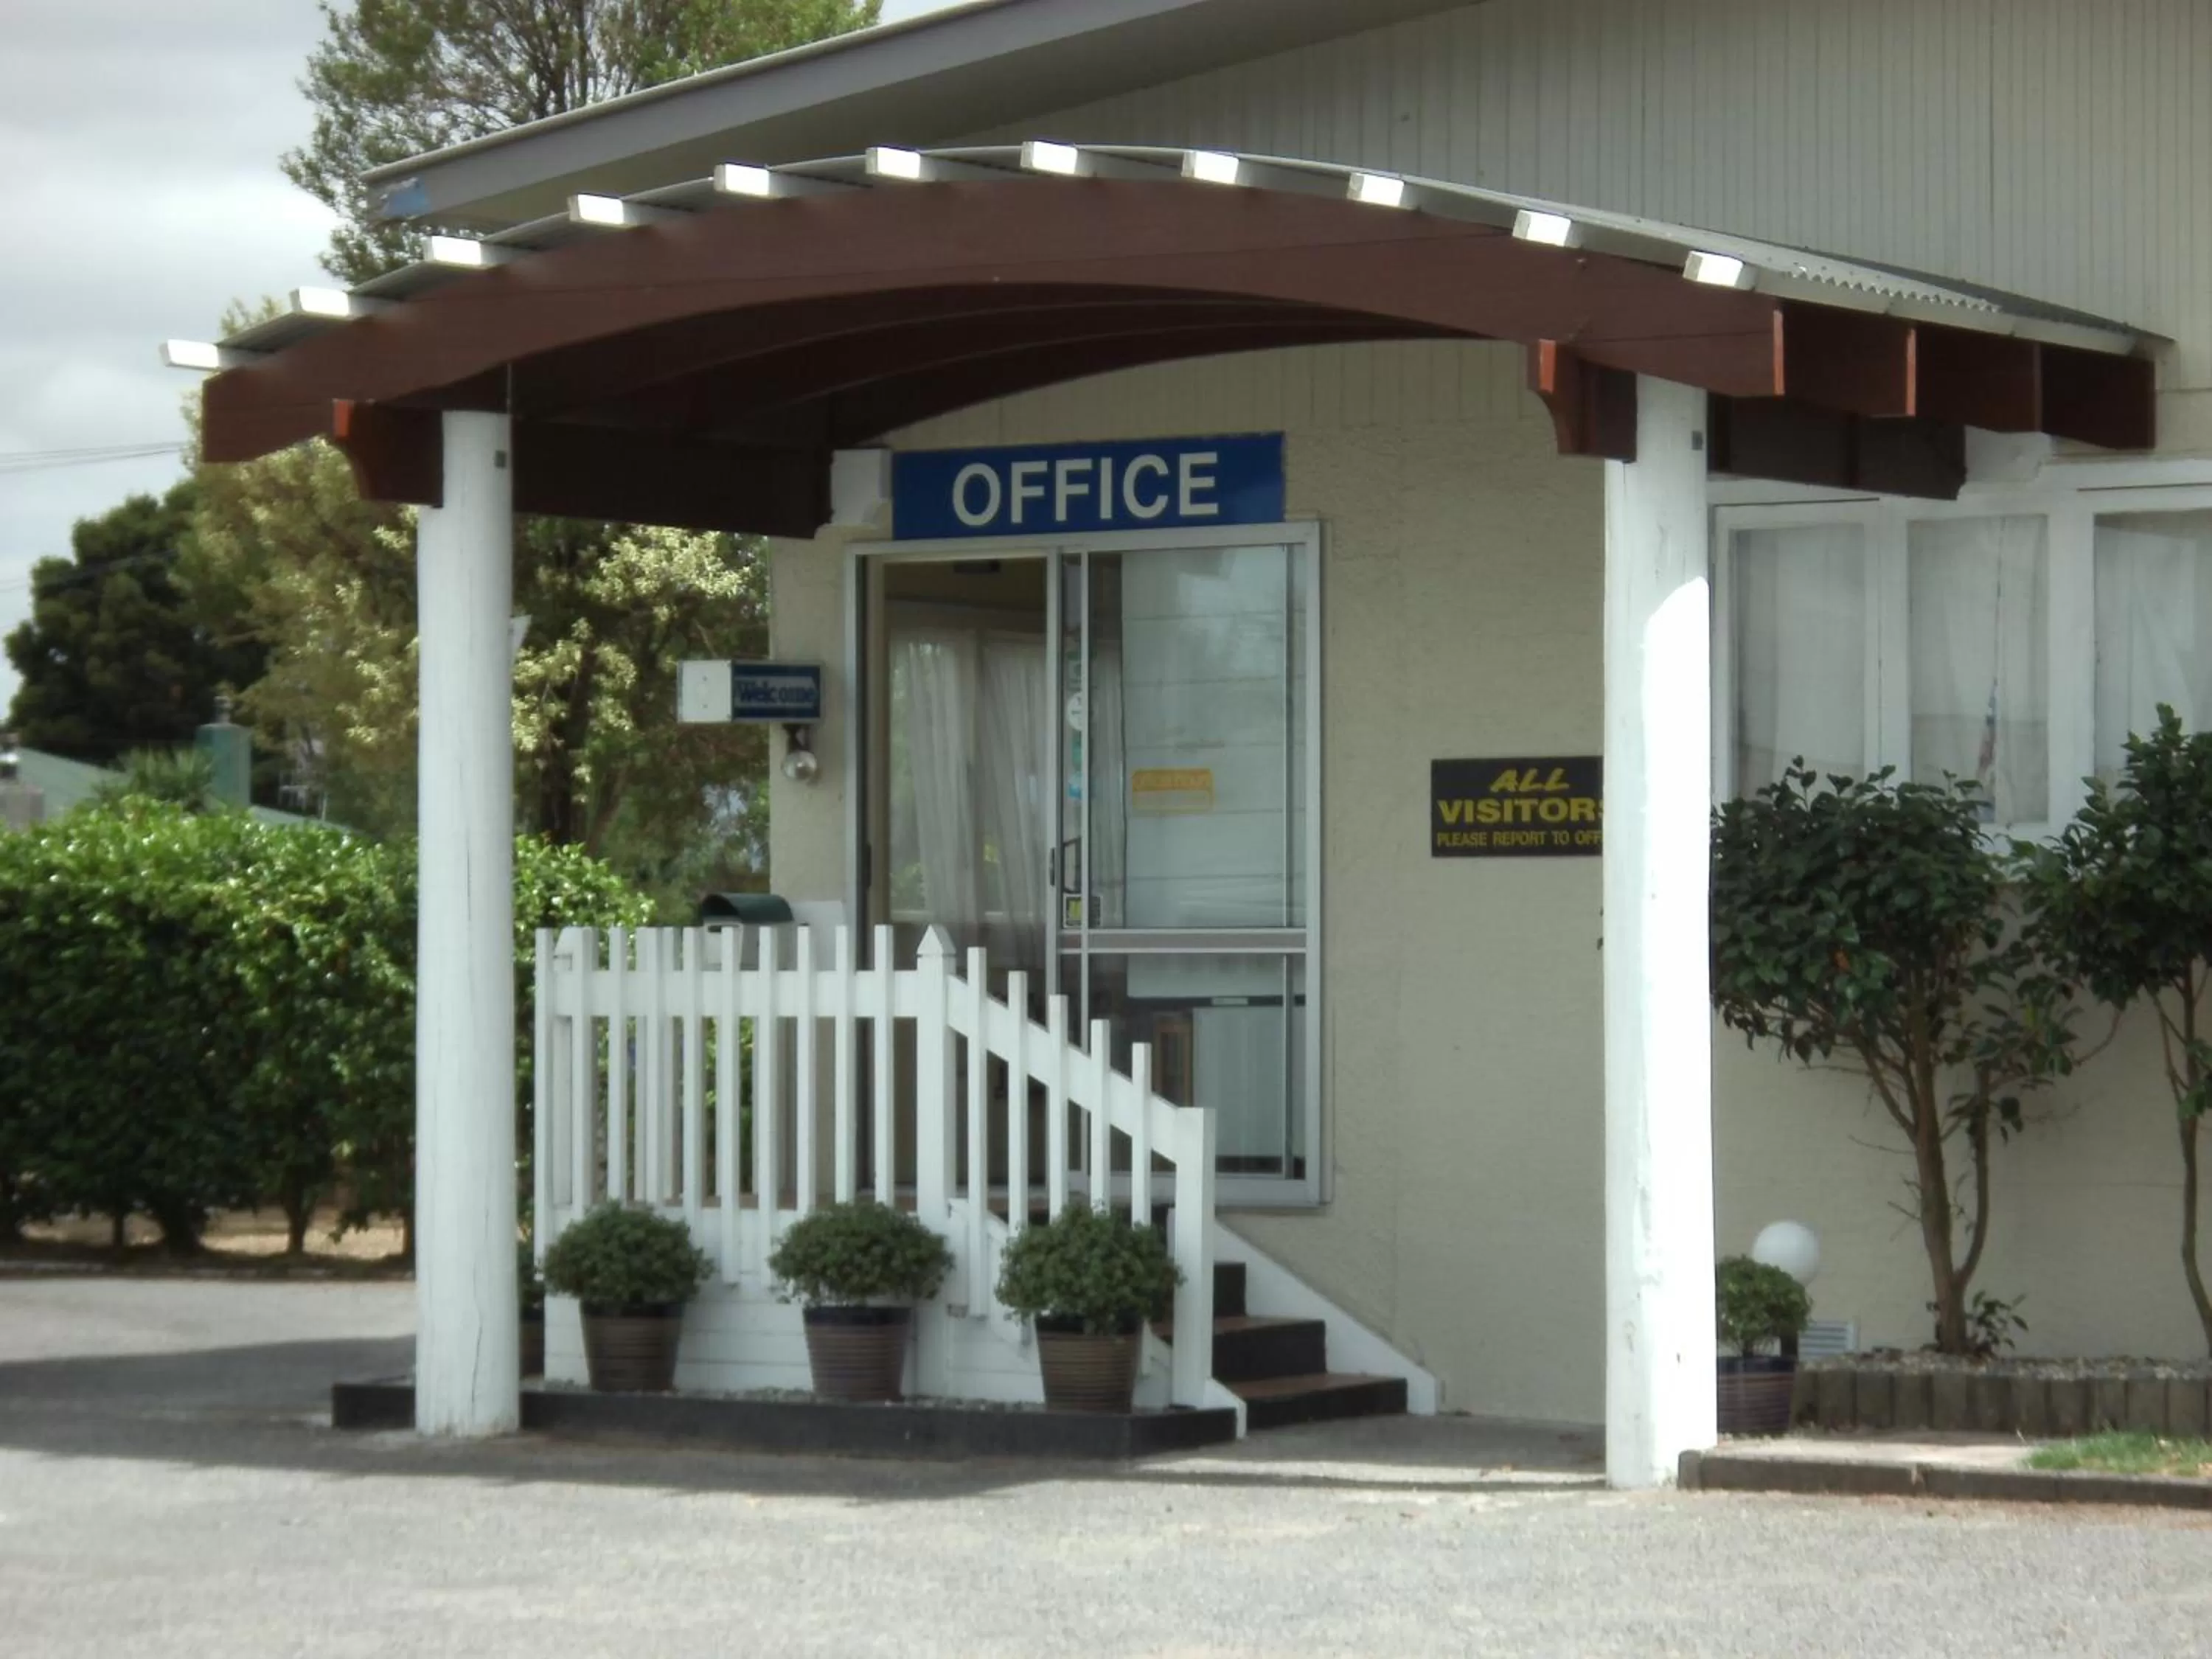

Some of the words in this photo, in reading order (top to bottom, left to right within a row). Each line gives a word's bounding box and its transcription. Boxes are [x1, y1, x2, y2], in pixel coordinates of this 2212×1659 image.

[953, 452, 1218, 526] OFFICE
[1489, 767, 1570, 793] ALL
[1437, 831, 1487, 846] PLEASE
[1492, 830, 1546, 846] REPORT
[1551, 830, 1570, 845] TO
[1574, 830, 1603, 845] OFF
